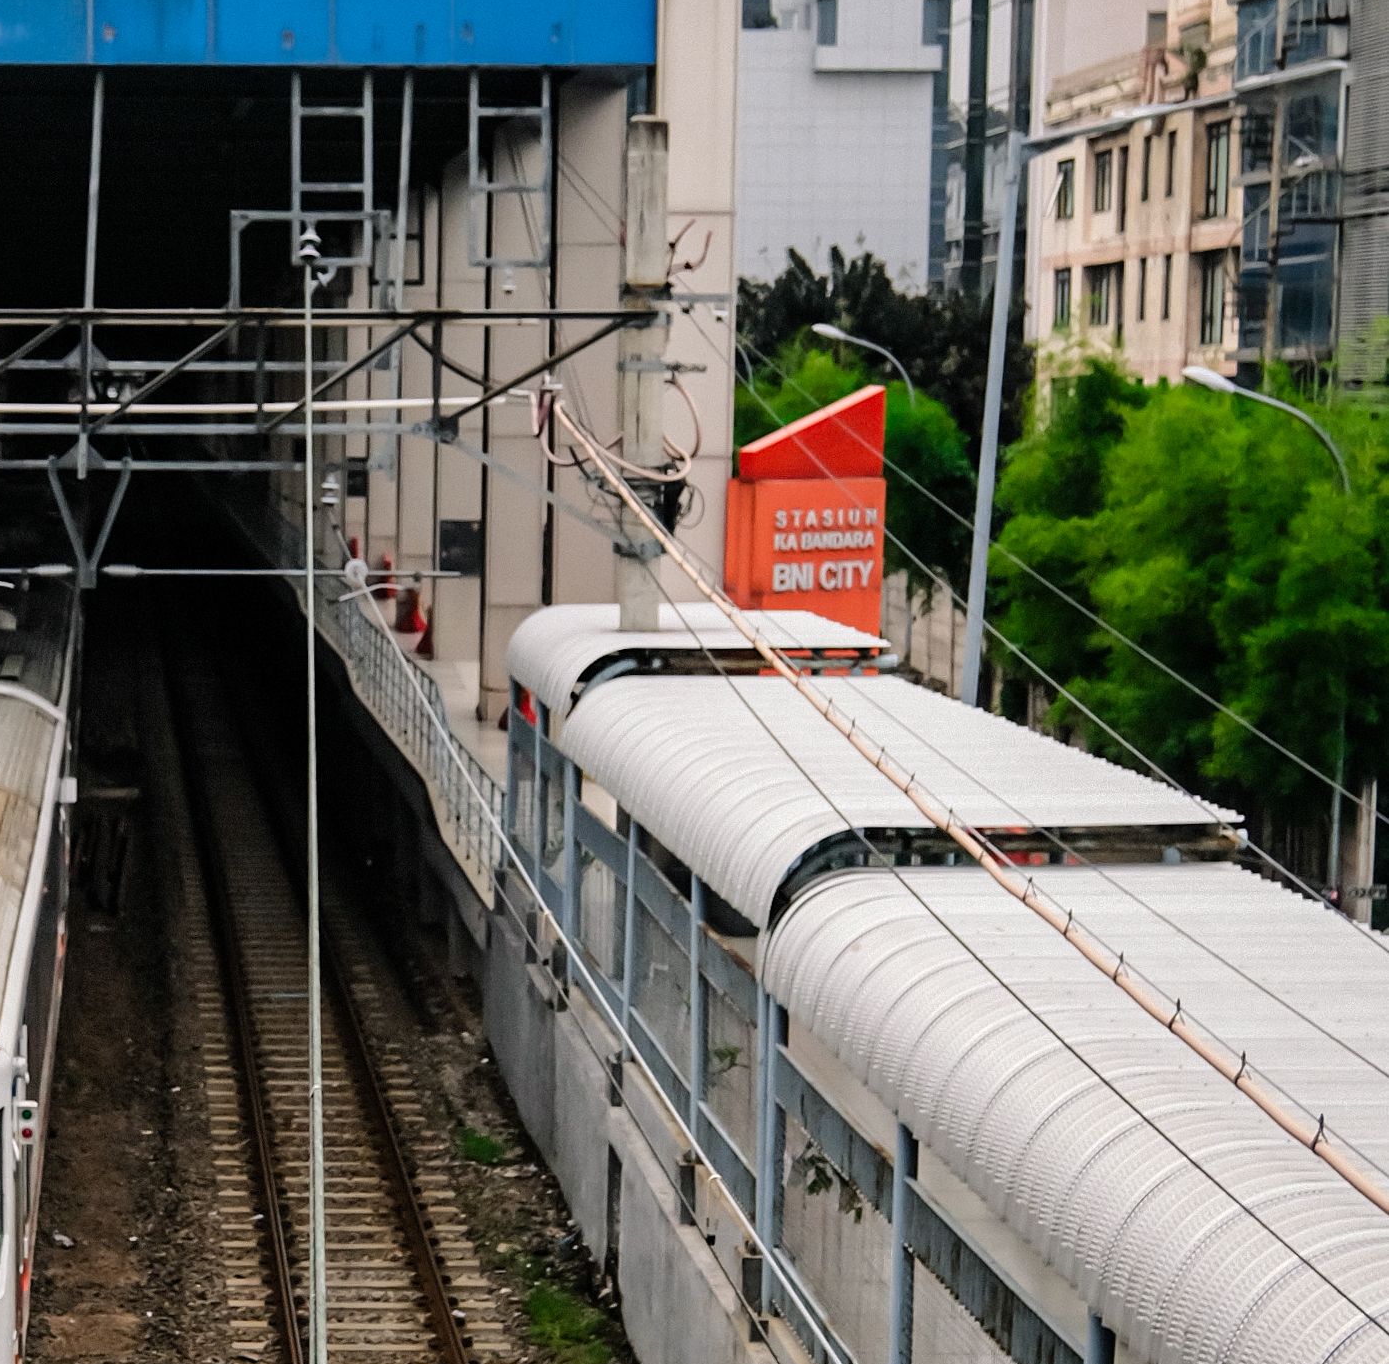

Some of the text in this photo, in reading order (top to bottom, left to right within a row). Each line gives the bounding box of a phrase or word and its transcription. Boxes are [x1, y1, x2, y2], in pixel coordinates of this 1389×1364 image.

[775, 508, 877, 529] STASIUN
[772, 559, 874, 592] BNI CITY
